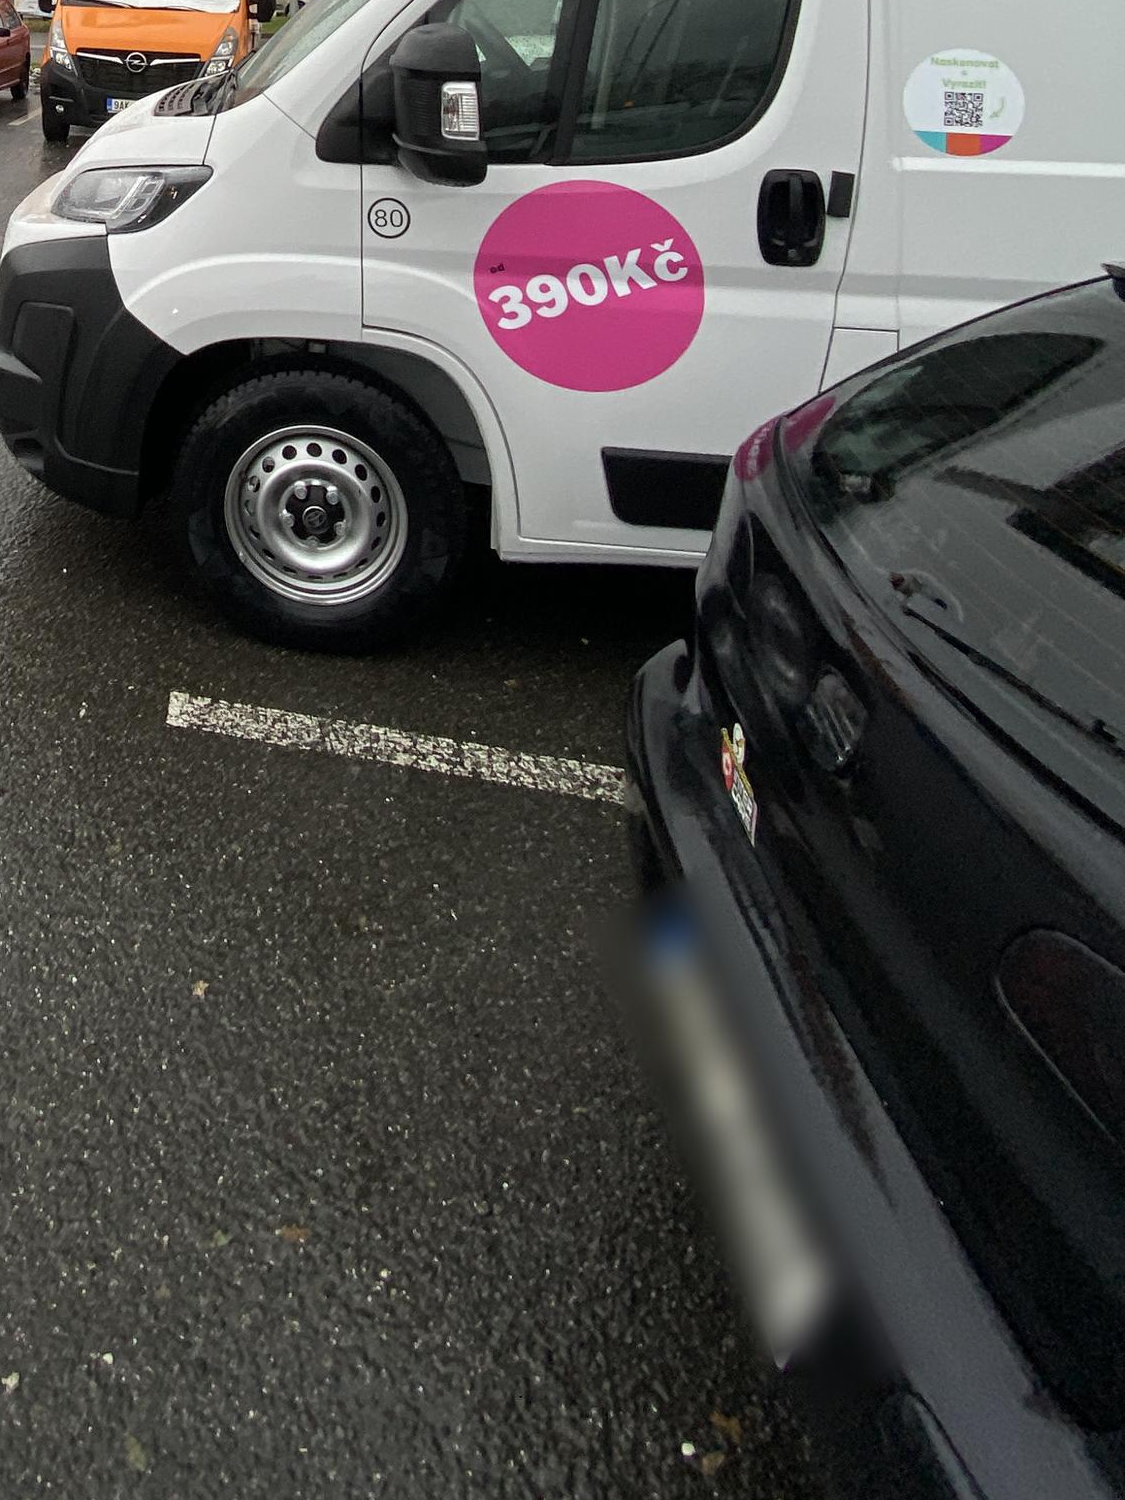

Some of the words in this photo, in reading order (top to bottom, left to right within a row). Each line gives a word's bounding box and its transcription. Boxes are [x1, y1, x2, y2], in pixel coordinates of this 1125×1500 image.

[374, 208, 404, 229] 80
[489, 263, 505, 274] od
[488, 238, 689, 330] 390Kč
